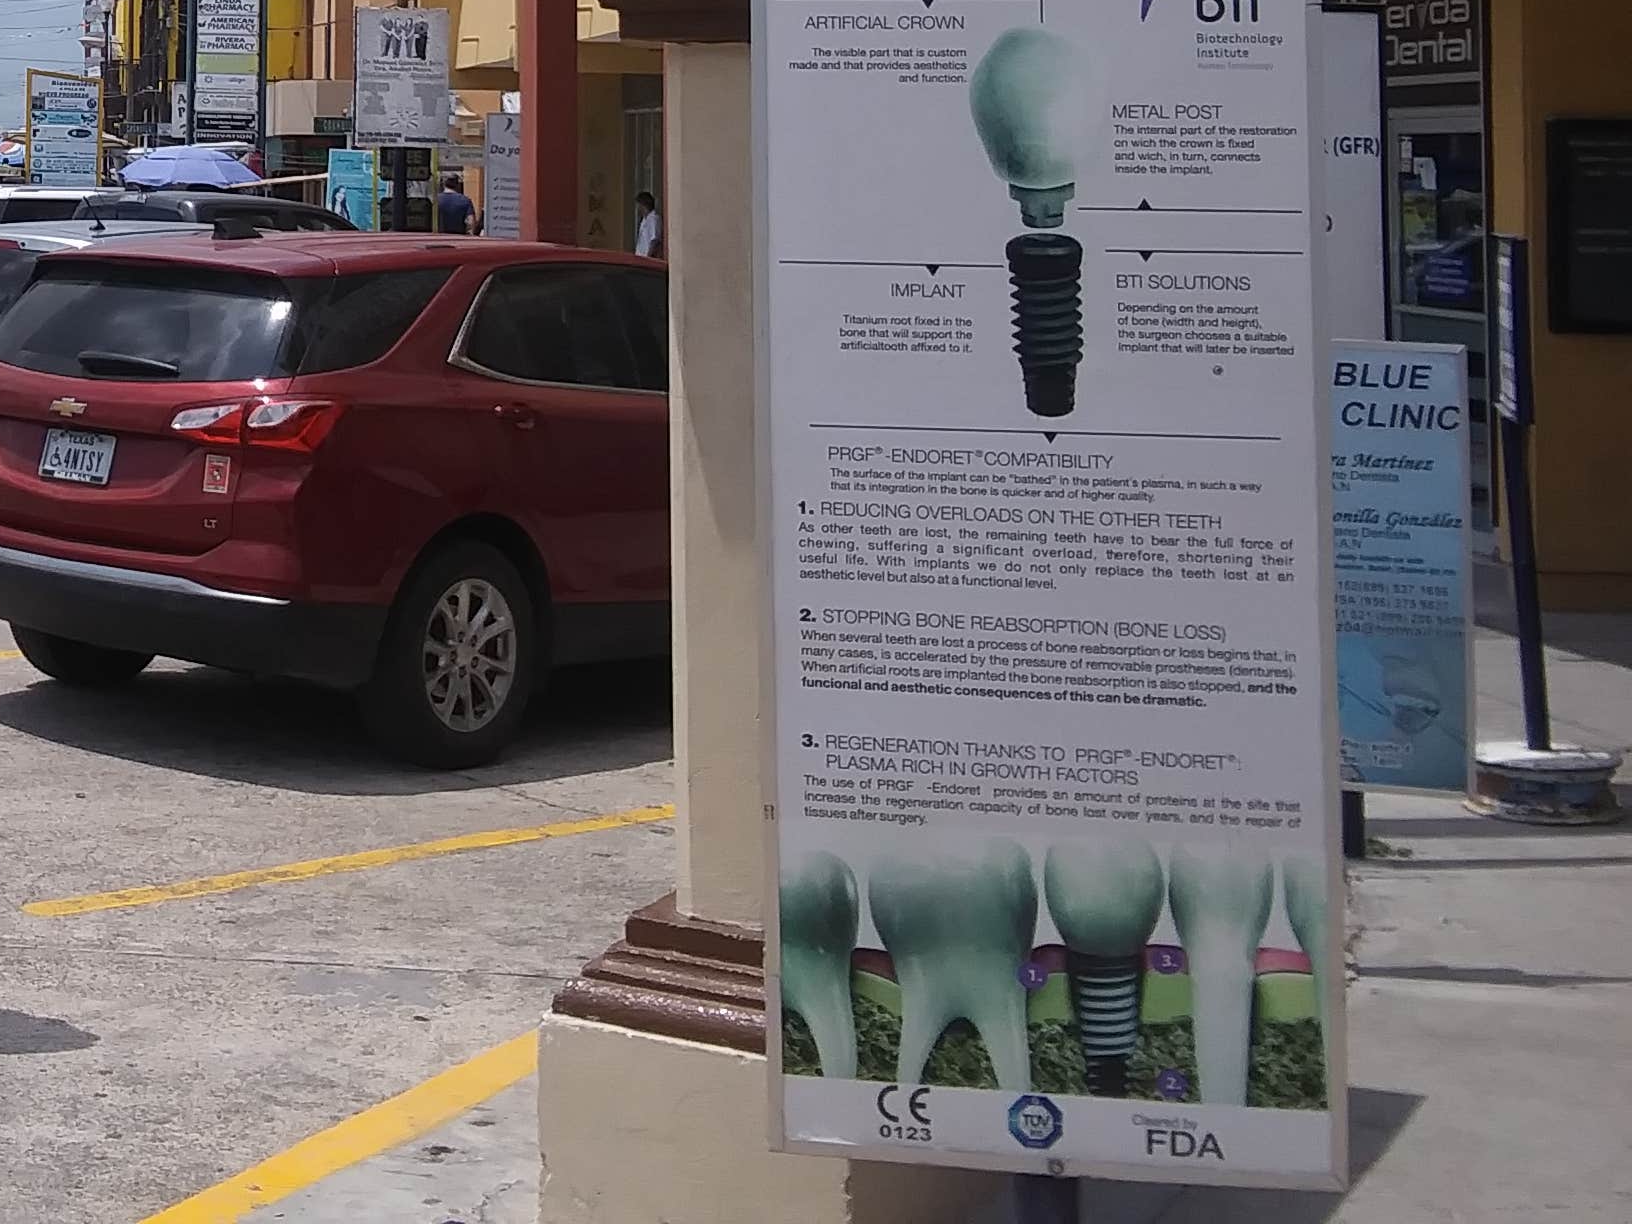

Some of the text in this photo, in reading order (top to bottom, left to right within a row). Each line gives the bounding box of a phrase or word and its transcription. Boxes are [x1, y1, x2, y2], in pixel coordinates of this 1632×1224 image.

[207, 24, 255, 32] PHARMACY
[805, 15, 964, 30] ARTIFICIAL CROWN
[206, 43, 255, 52] PHARMACY
[1196, 33, 1283, 46] Biotechnology
[1197, 48, 1249, 58] Institute
[1113, 105, 1223, 120] METAL POST
[891, 283, 966, 298] IMPLANT
[1116, 274, 1251, 291] BTI SOLUTIONS
[1333, 362, 1432, 390] BLUE
[1341, 401, 1461, 431] CLINIC
[69, 435, 95, 446] TEXAS
[63, 448, 105, 473] 4NTSY
[204, 518, 216, 529] LT
[821, 501, 1222, 529] REDUCING OVERLOADS ON THE OTHER TEETH
[822, 609, 1226, 643] STOPPING BONE REABSORPTION (BONE LOSS)
[825, 735, 1066, 761] REGENERATION THANKS TO
[826, 754, 1139, 786] PLASMA RICH IN GROWTH FACTORS
[877, 1085, 931, 1125] CE
[880, 1124, 932, 1142] 0123
[1145, 1128, 1225, 1160] FDA
